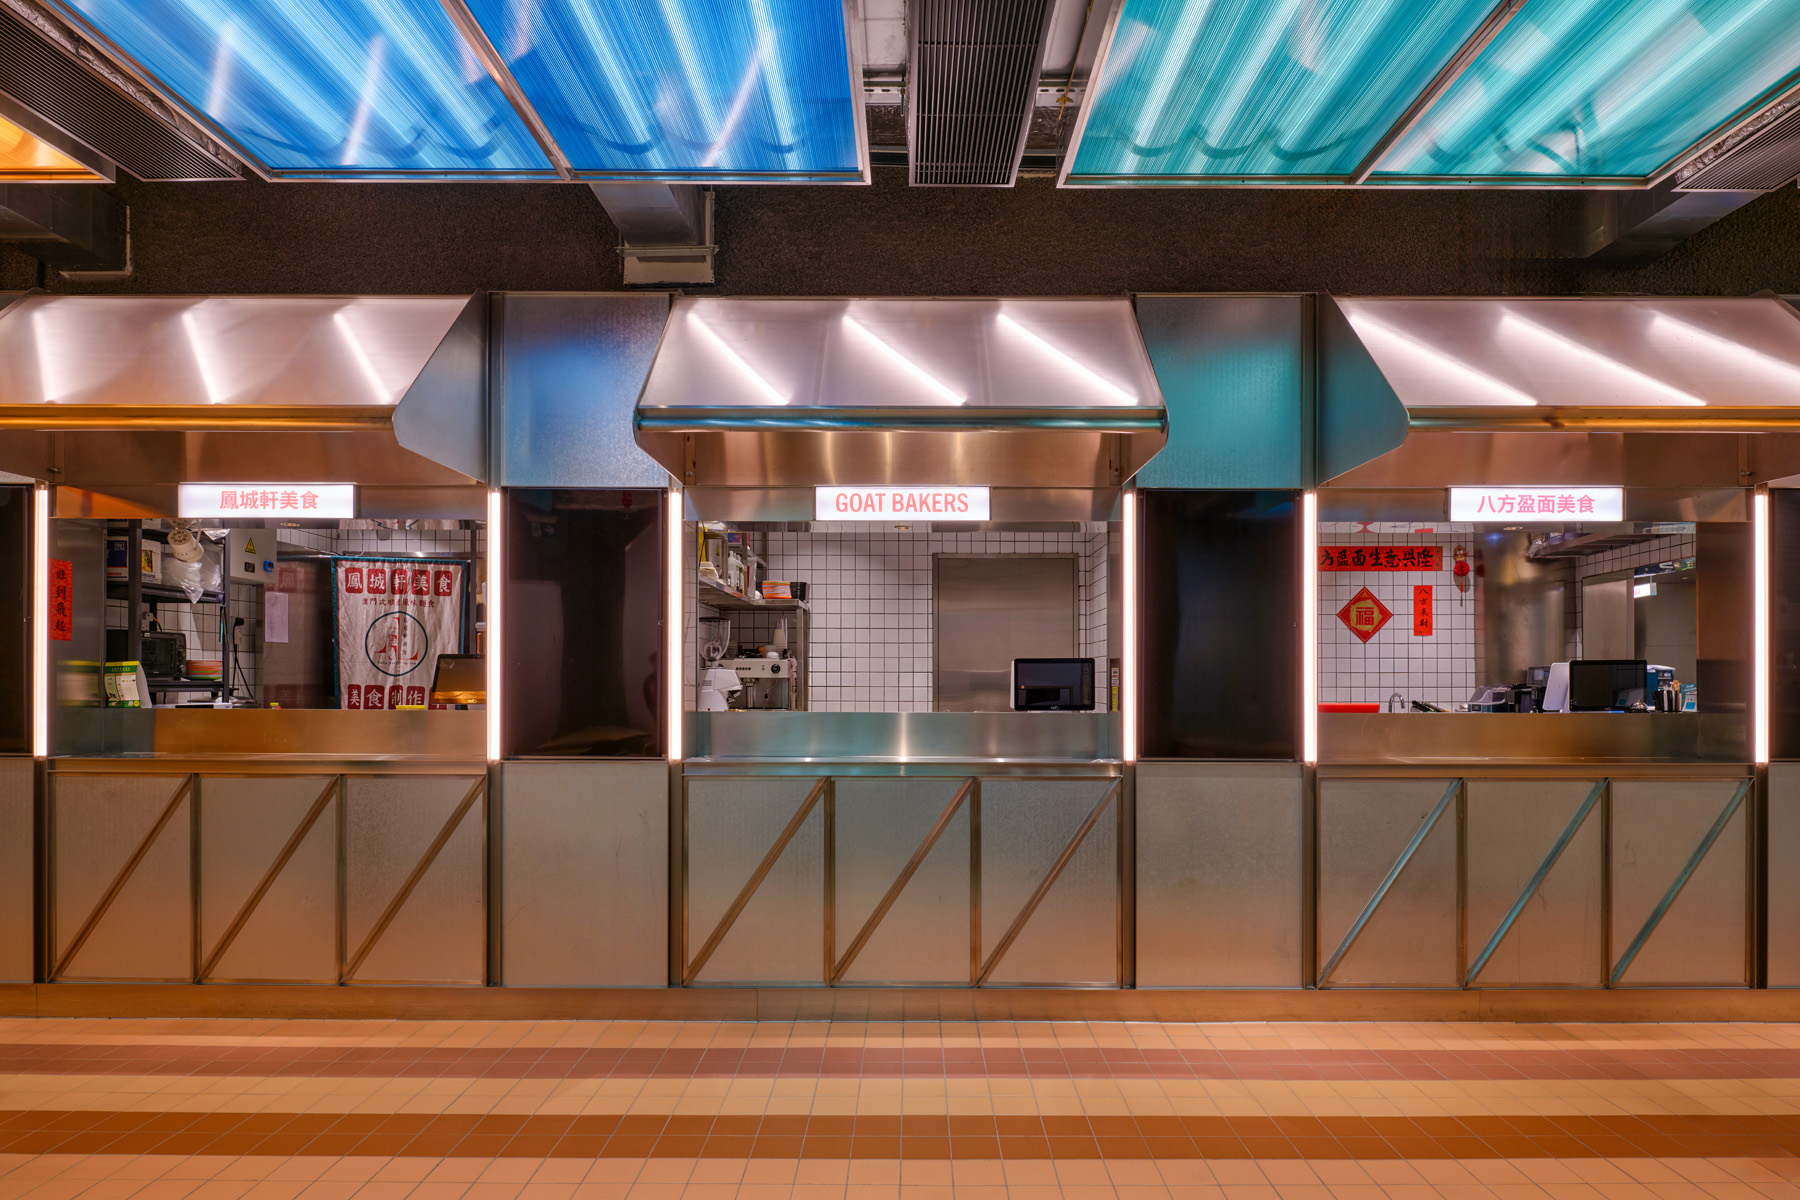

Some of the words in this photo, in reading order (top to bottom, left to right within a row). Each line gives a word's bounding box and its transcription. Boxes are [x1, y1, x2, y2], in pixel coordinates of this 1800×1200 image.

[219, 490, 319, 510] 鳳城軒美食
[835, 492, 886, 513] GOAT
[892, 492, 969, 513] BAKERS
[1477, 494, 1596, 513] 八方盈面美食
[1317, 547, 1433, 568] 方盈面生意興隆
[347, 572, 451, 593] 鳳城軒美食
[1355, 606, 1375, 626] 福
